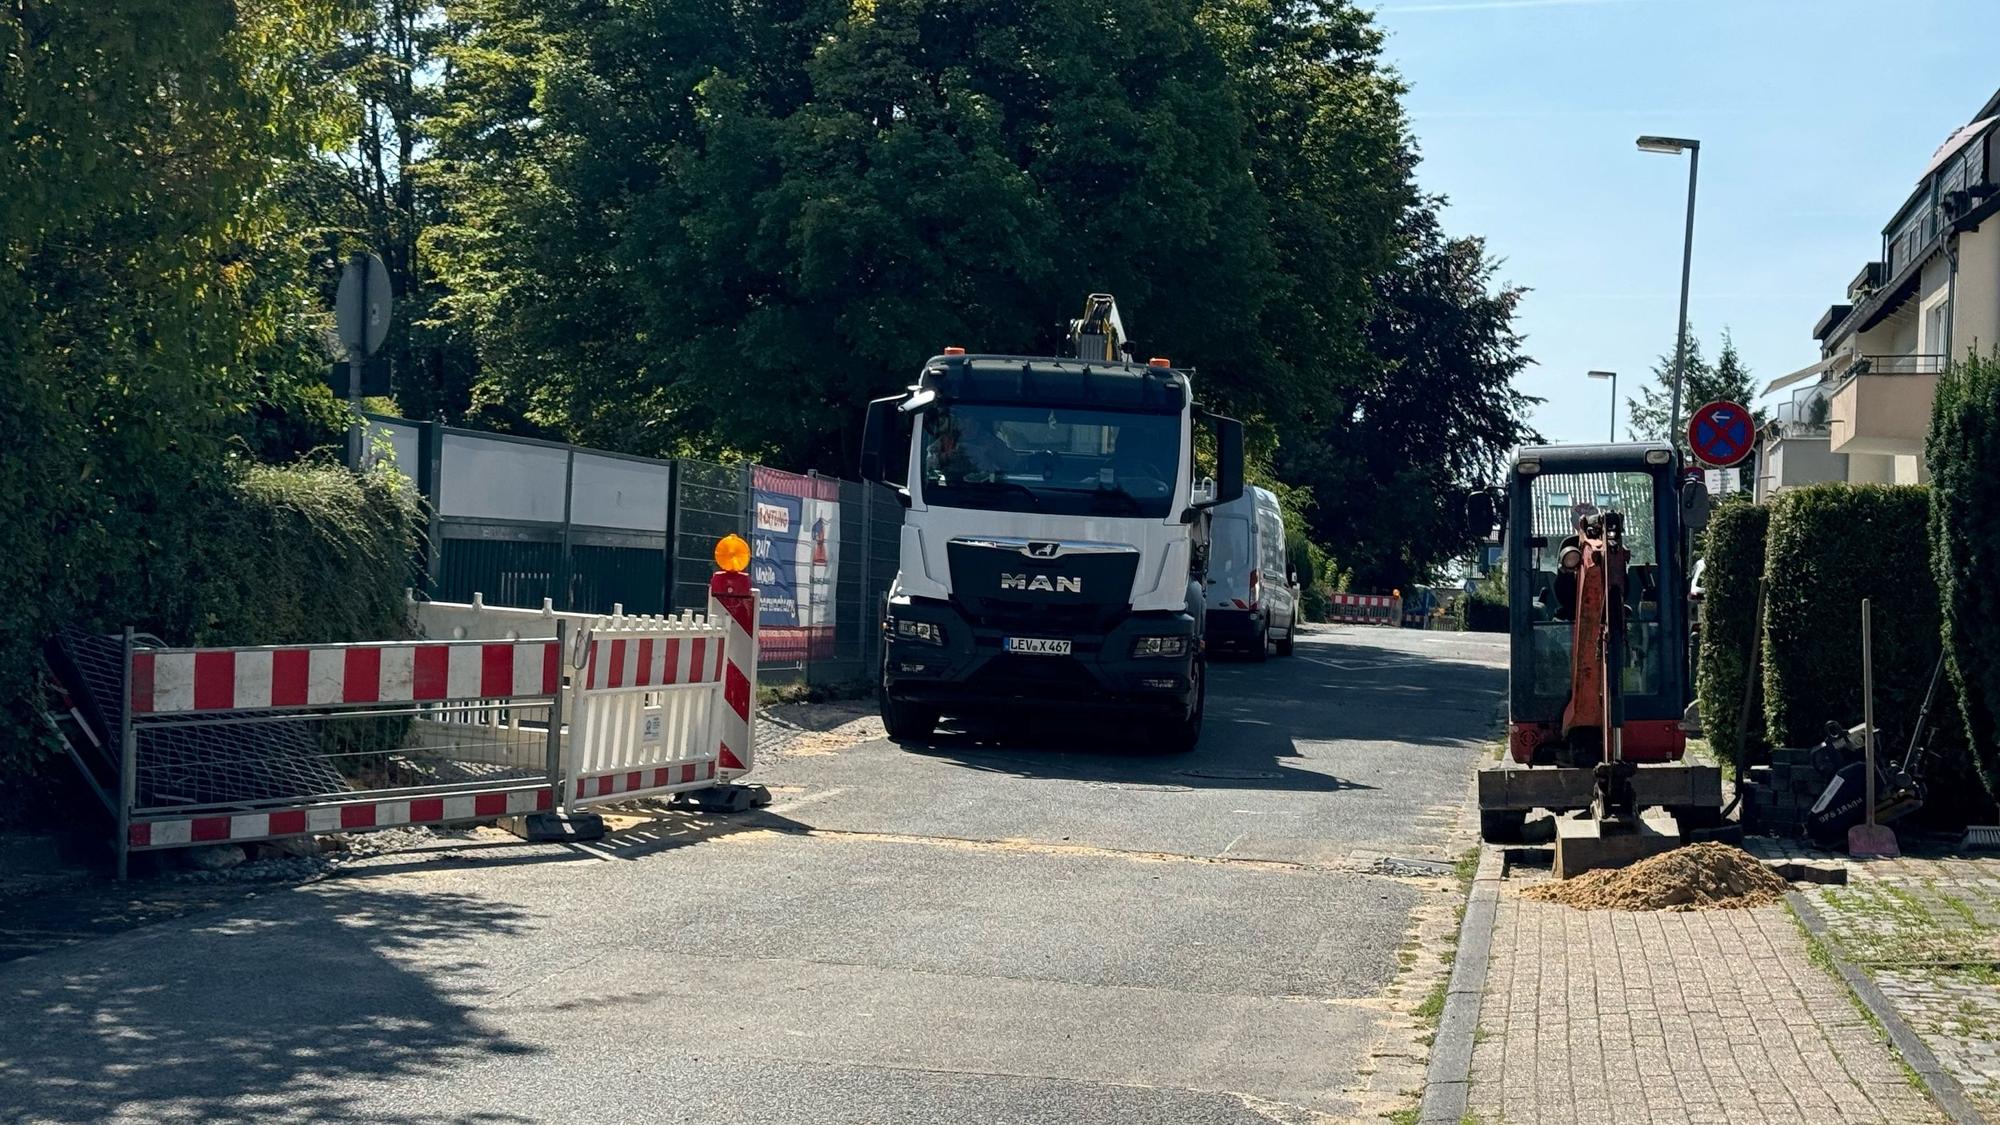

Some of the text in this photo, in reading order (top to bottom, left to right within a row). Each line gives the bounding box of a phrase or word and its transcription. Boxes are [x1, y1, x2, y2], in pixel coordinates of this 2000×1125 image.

[756, 539, 771, 559] 24/7
[755, 566, 776, 585] Mobile
[1001, 573, 1081, 593] MAN
[760, 595, 795, 618] ewachung
[1010, 639, 1070, 652] LEV X 467
